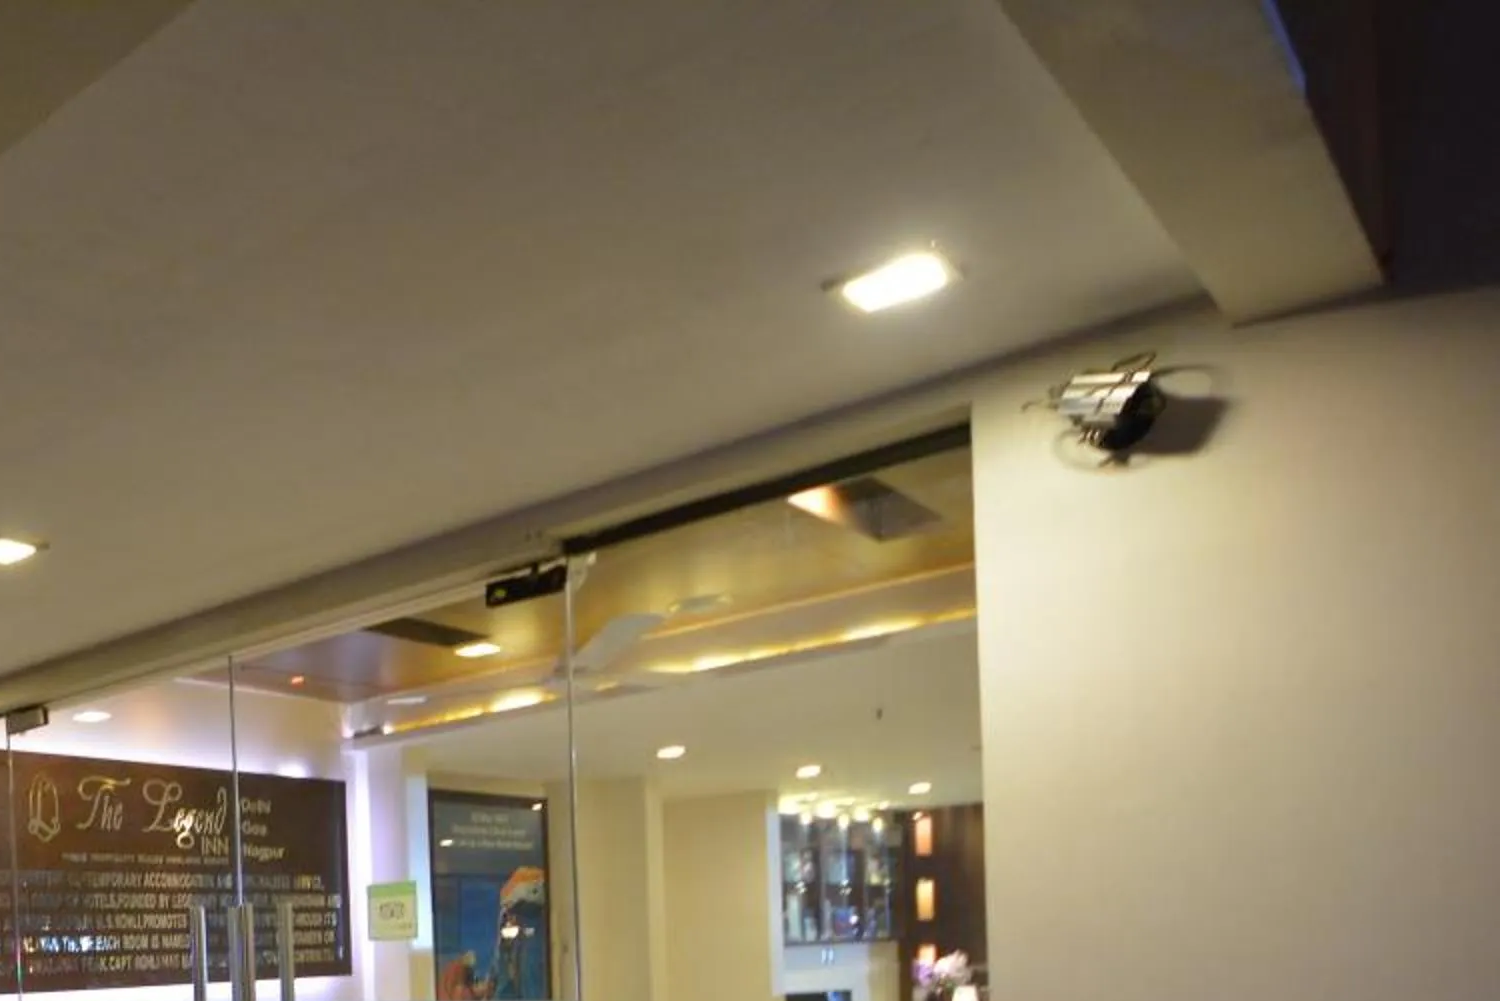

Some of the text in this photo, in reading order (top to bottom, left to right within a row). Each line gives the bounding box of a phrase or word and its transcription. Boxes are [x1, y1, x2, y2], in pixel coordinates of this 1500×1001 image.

[76, 775, 228, 850] The Legend
[201, 835, 230, 856] INN
[243, 843, 286, 862] Nagpur
